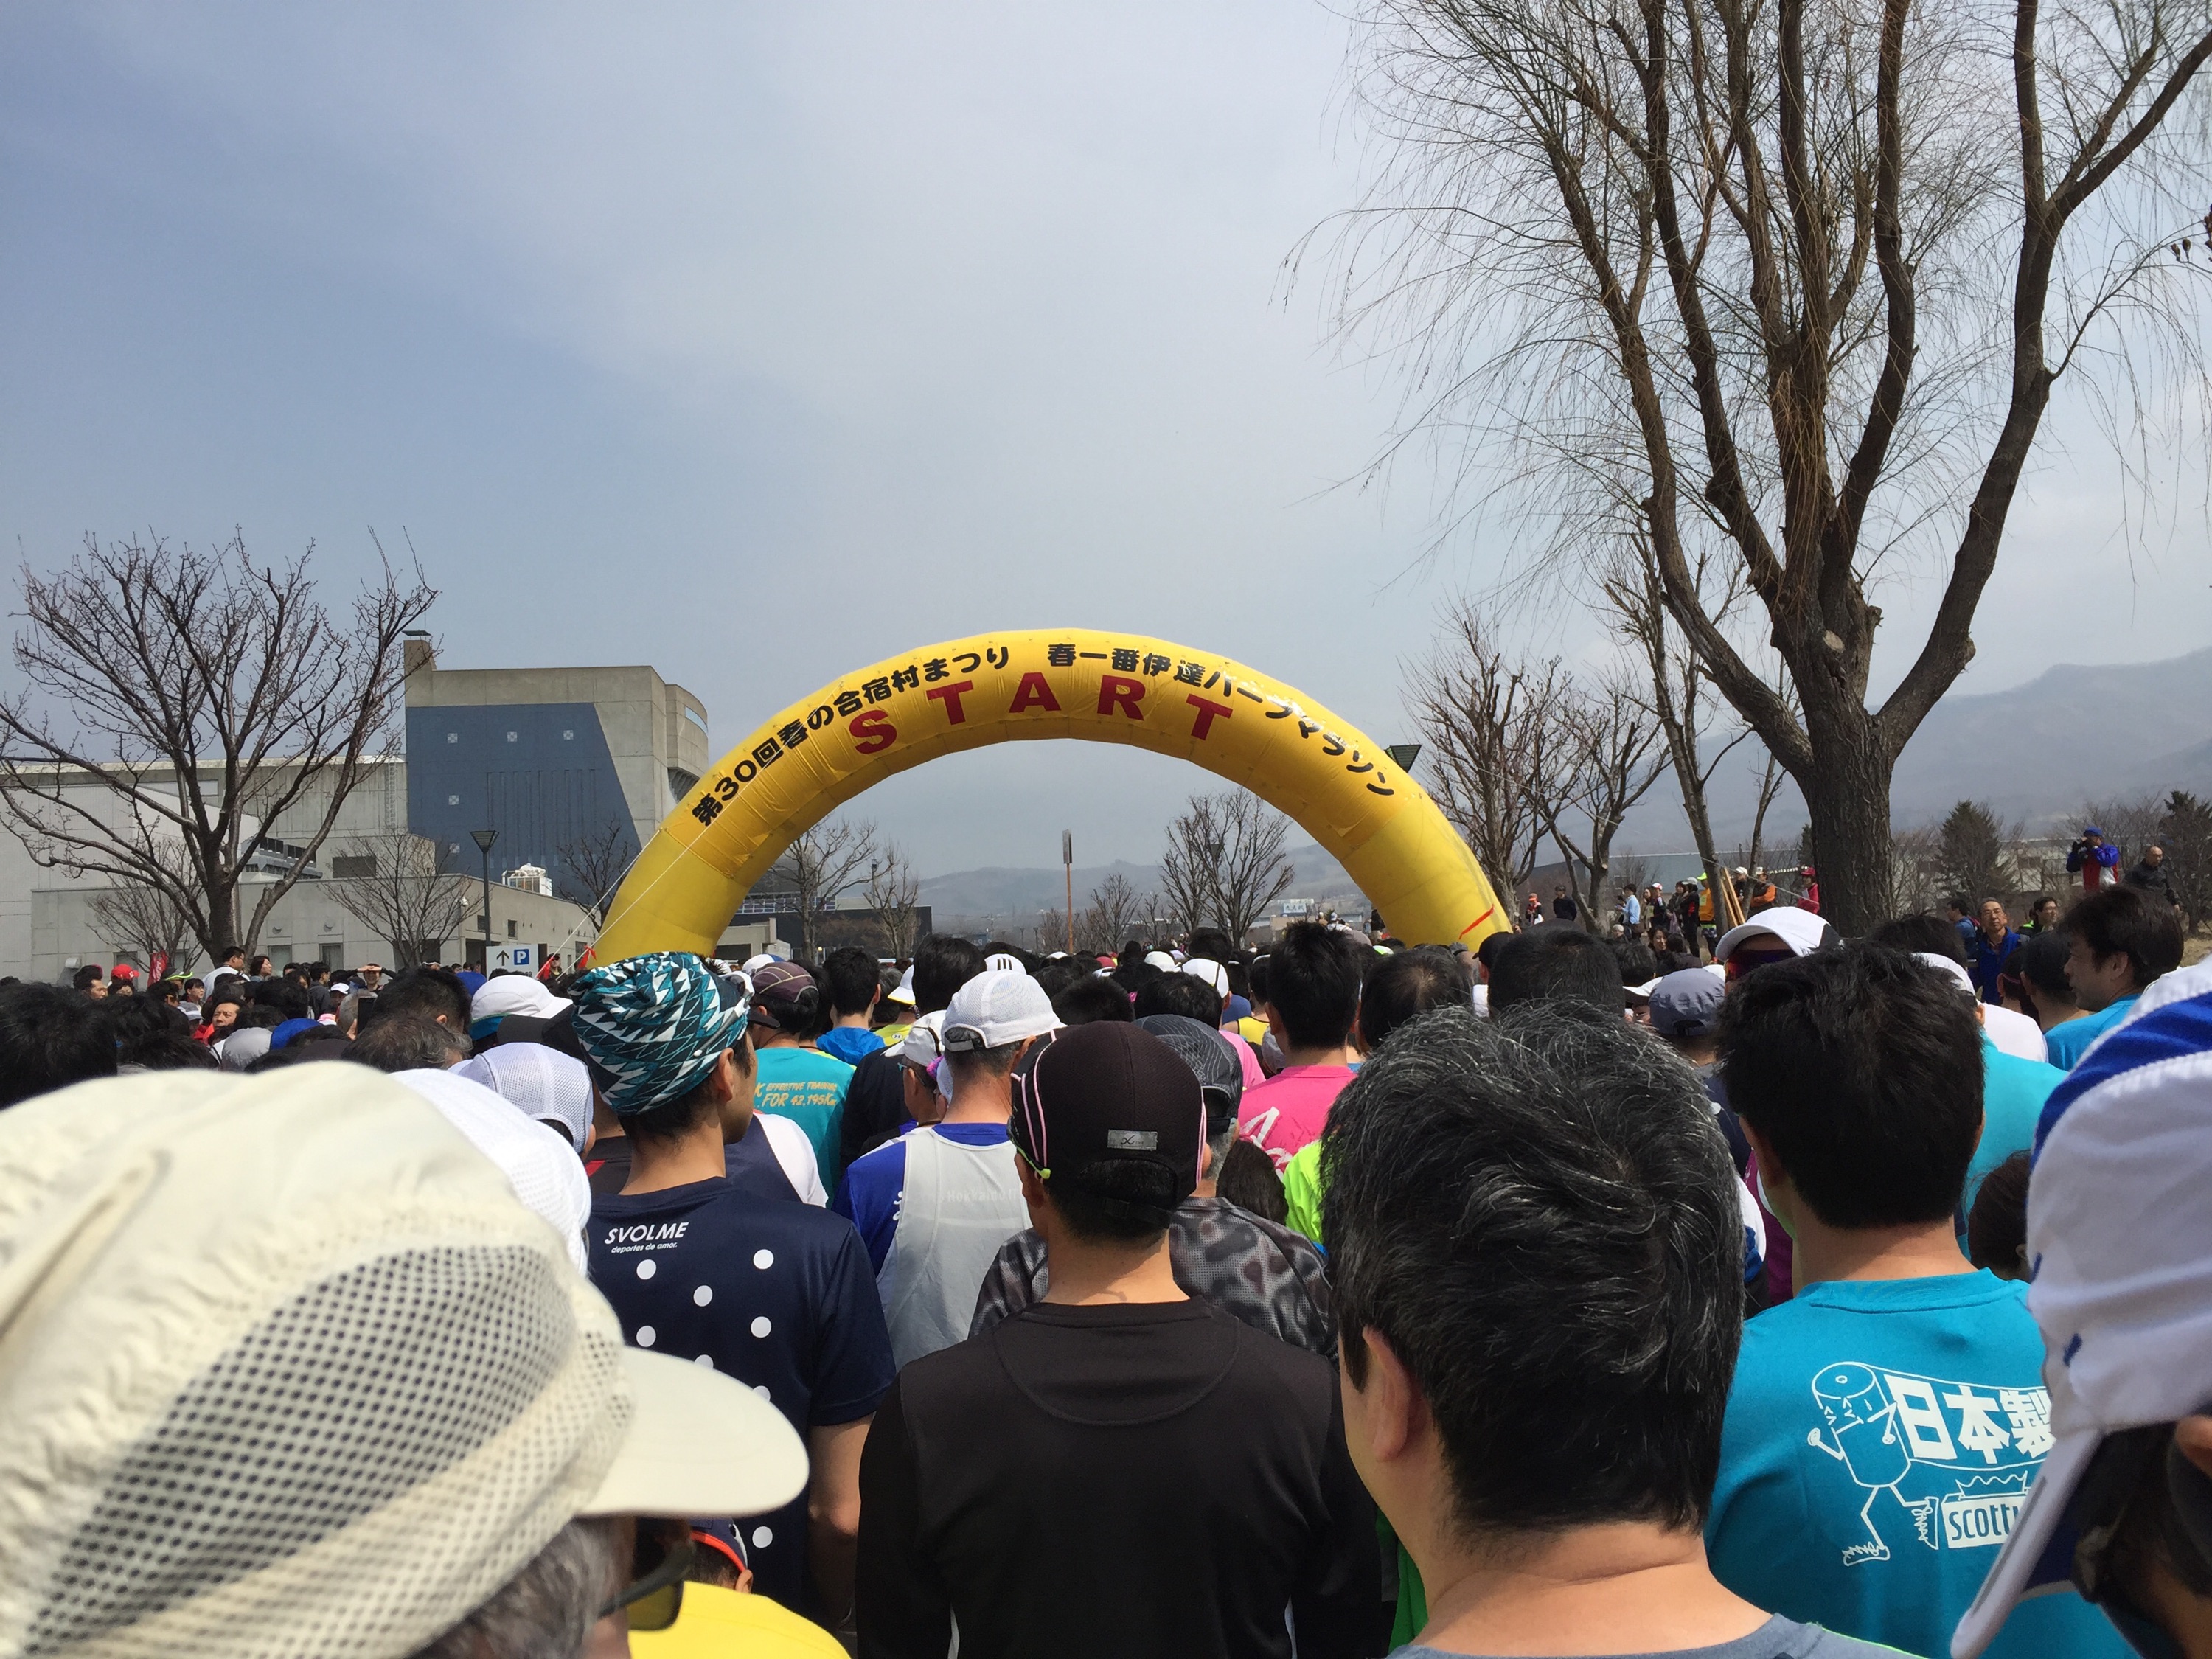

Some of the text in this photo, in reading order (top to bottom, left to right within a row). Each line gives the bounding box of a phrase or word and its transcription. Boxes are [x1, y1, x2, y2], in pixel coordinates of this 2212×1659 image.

[849, 672, 1233, 754] START
[692, 643, 1395, 827] 第30回春の合宿村まつり 春一番伊達ハーフマラソン
[516, 950, 528, 964] P
[762, 1092, 789, 1107] FOR
[605, 1222, 689, 1245] SVOLME
[611, 1245, 644, 1253] deportes
[1884, 1374, 2056, 1464] 日本製
[1949, 1504, 2019, 1541] scott
